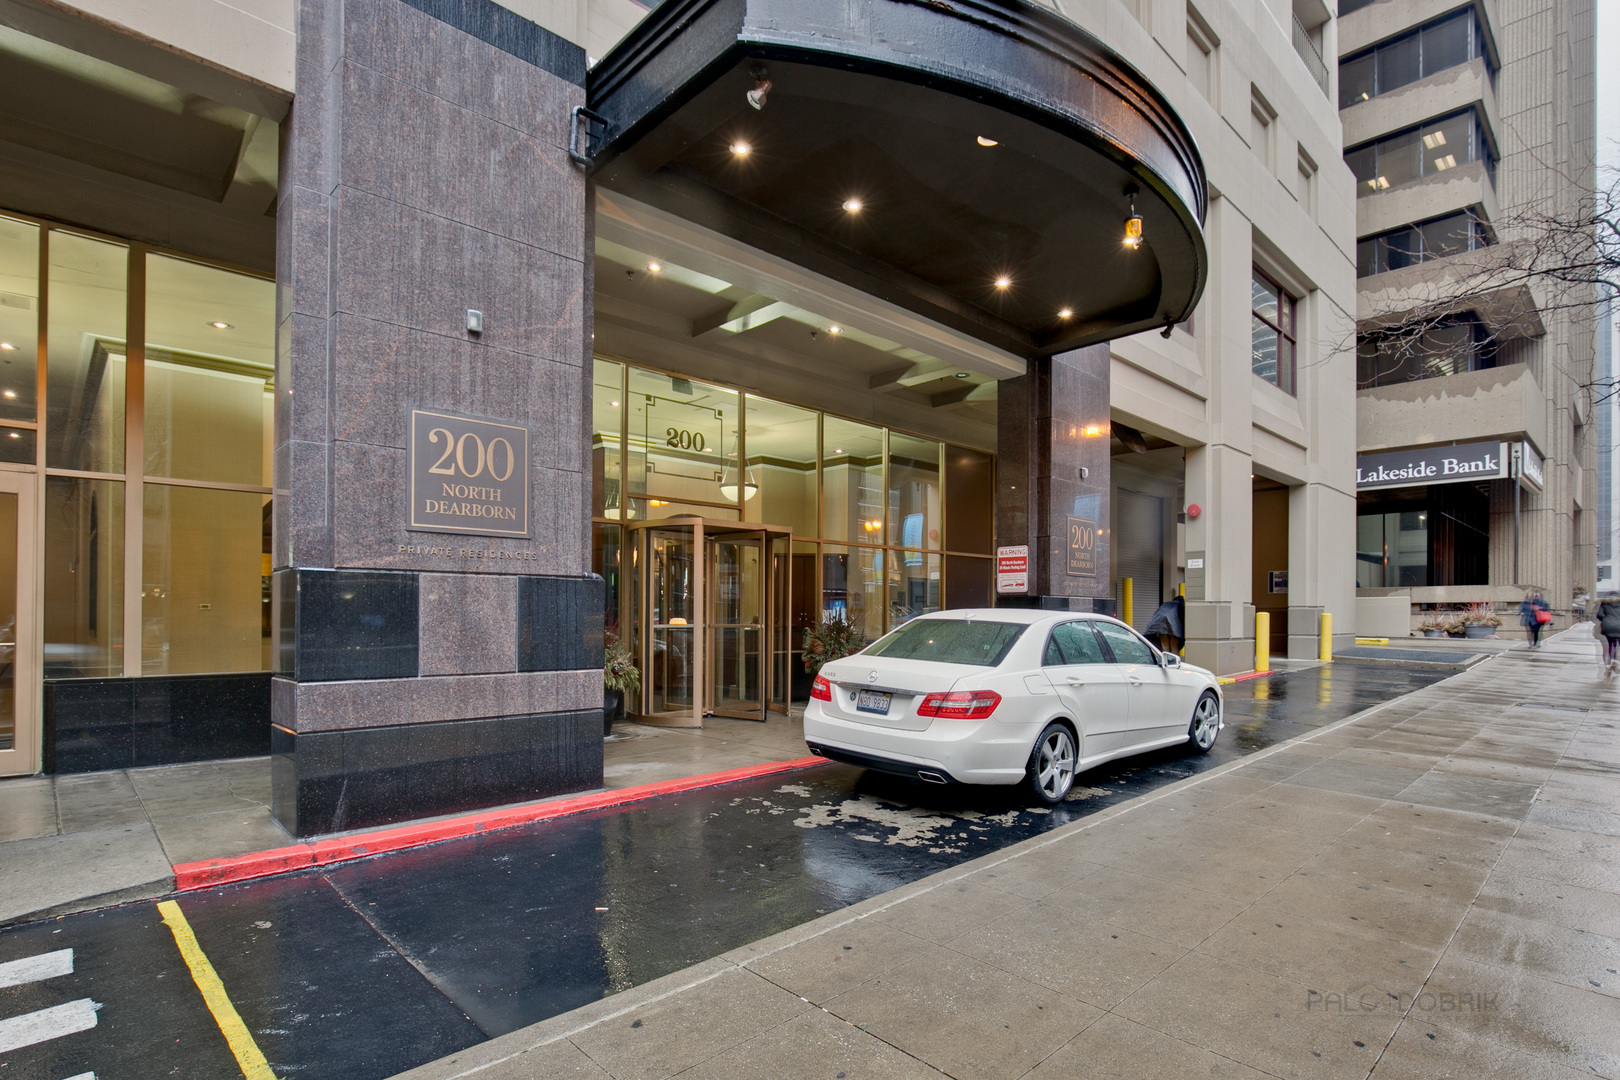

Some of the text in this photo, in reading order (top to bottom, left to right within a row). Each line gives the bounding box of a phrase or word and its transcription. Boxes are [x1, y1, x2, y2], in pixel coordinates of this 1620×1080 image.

[666, 427, 705, 452] 200
[428, 428, 515, 482] 200
[1356, 460, 1437, 483] Lakeside
[1442, 454, 1498, 475] Bank
[442, 483, 502, 502] NORTH
[425, 499, 516, 520] DEARBORN
[1071, 525, 1093, 550] 200
[398, 545, 537, 560] PRIVATE RESIDENCES
[1000, 548, 1026, 556] WARNING
